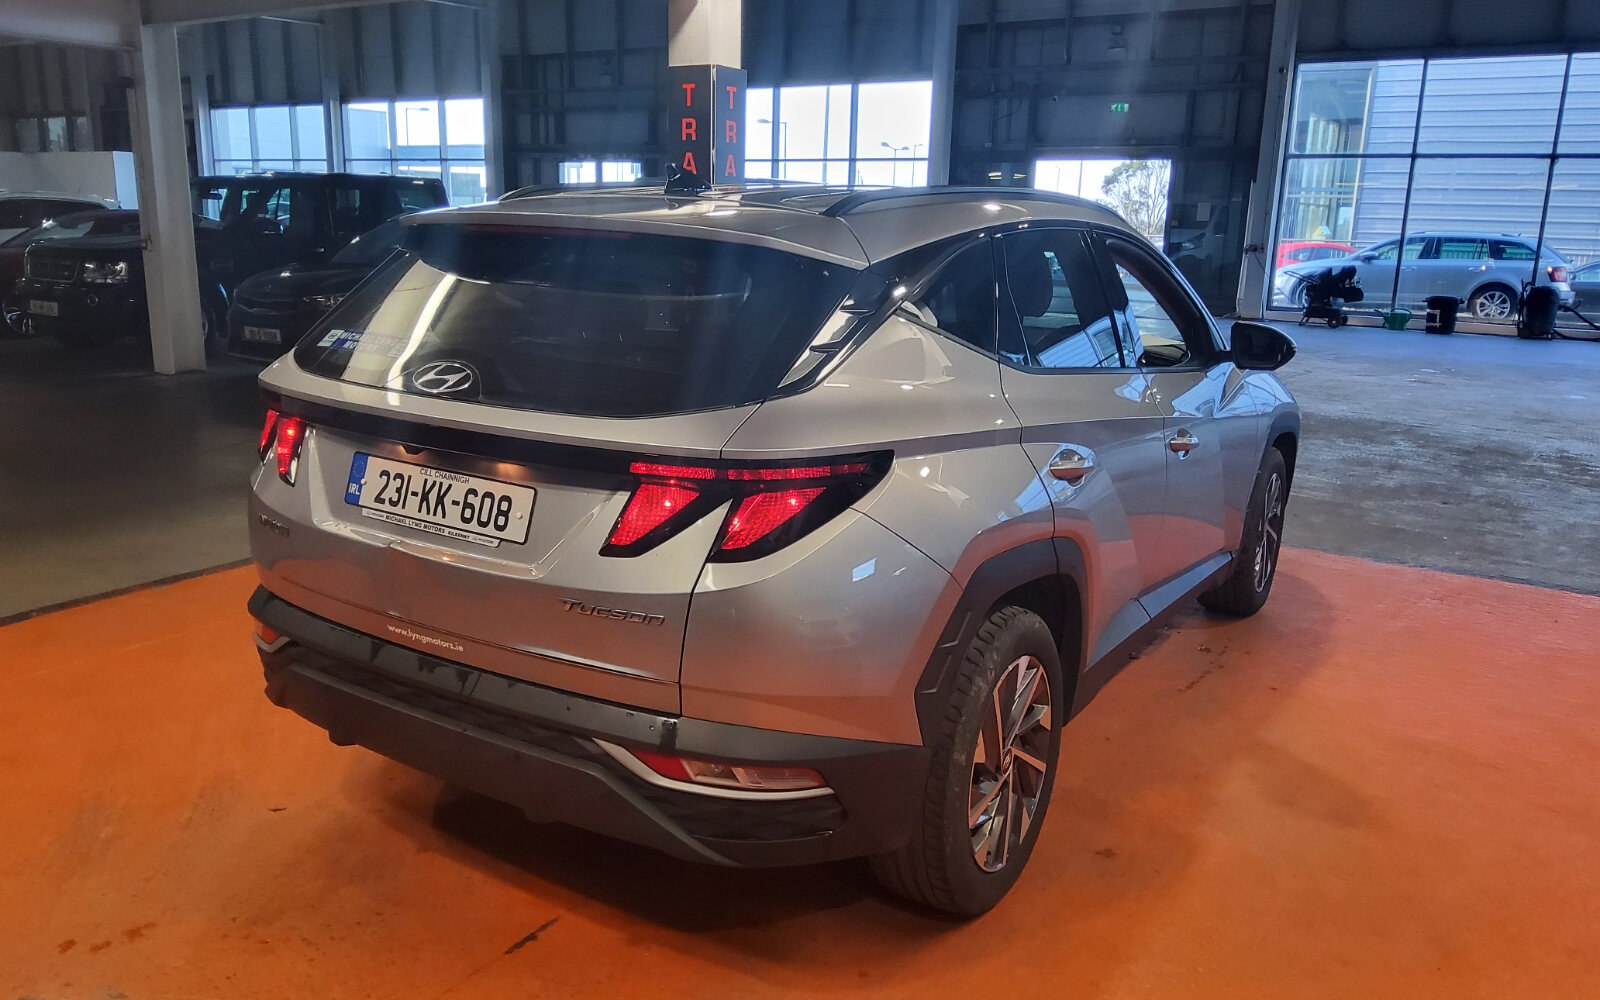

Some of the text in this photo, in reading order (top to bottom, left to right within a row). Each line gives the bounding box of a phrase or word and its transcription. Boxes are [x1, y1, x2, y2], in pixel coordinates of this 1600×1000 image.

[419, 467, 470, 485] CILL CHAINNIGH
[349, 482, 361, 496] IRL
[374, 469, 513, 532] 231-KK-608
[385, 515, 408, 525] MICHAEL
[423, 523, 446, 534] MOTORS
[387, 624, 464, 652] www.lyngmotors.ie
